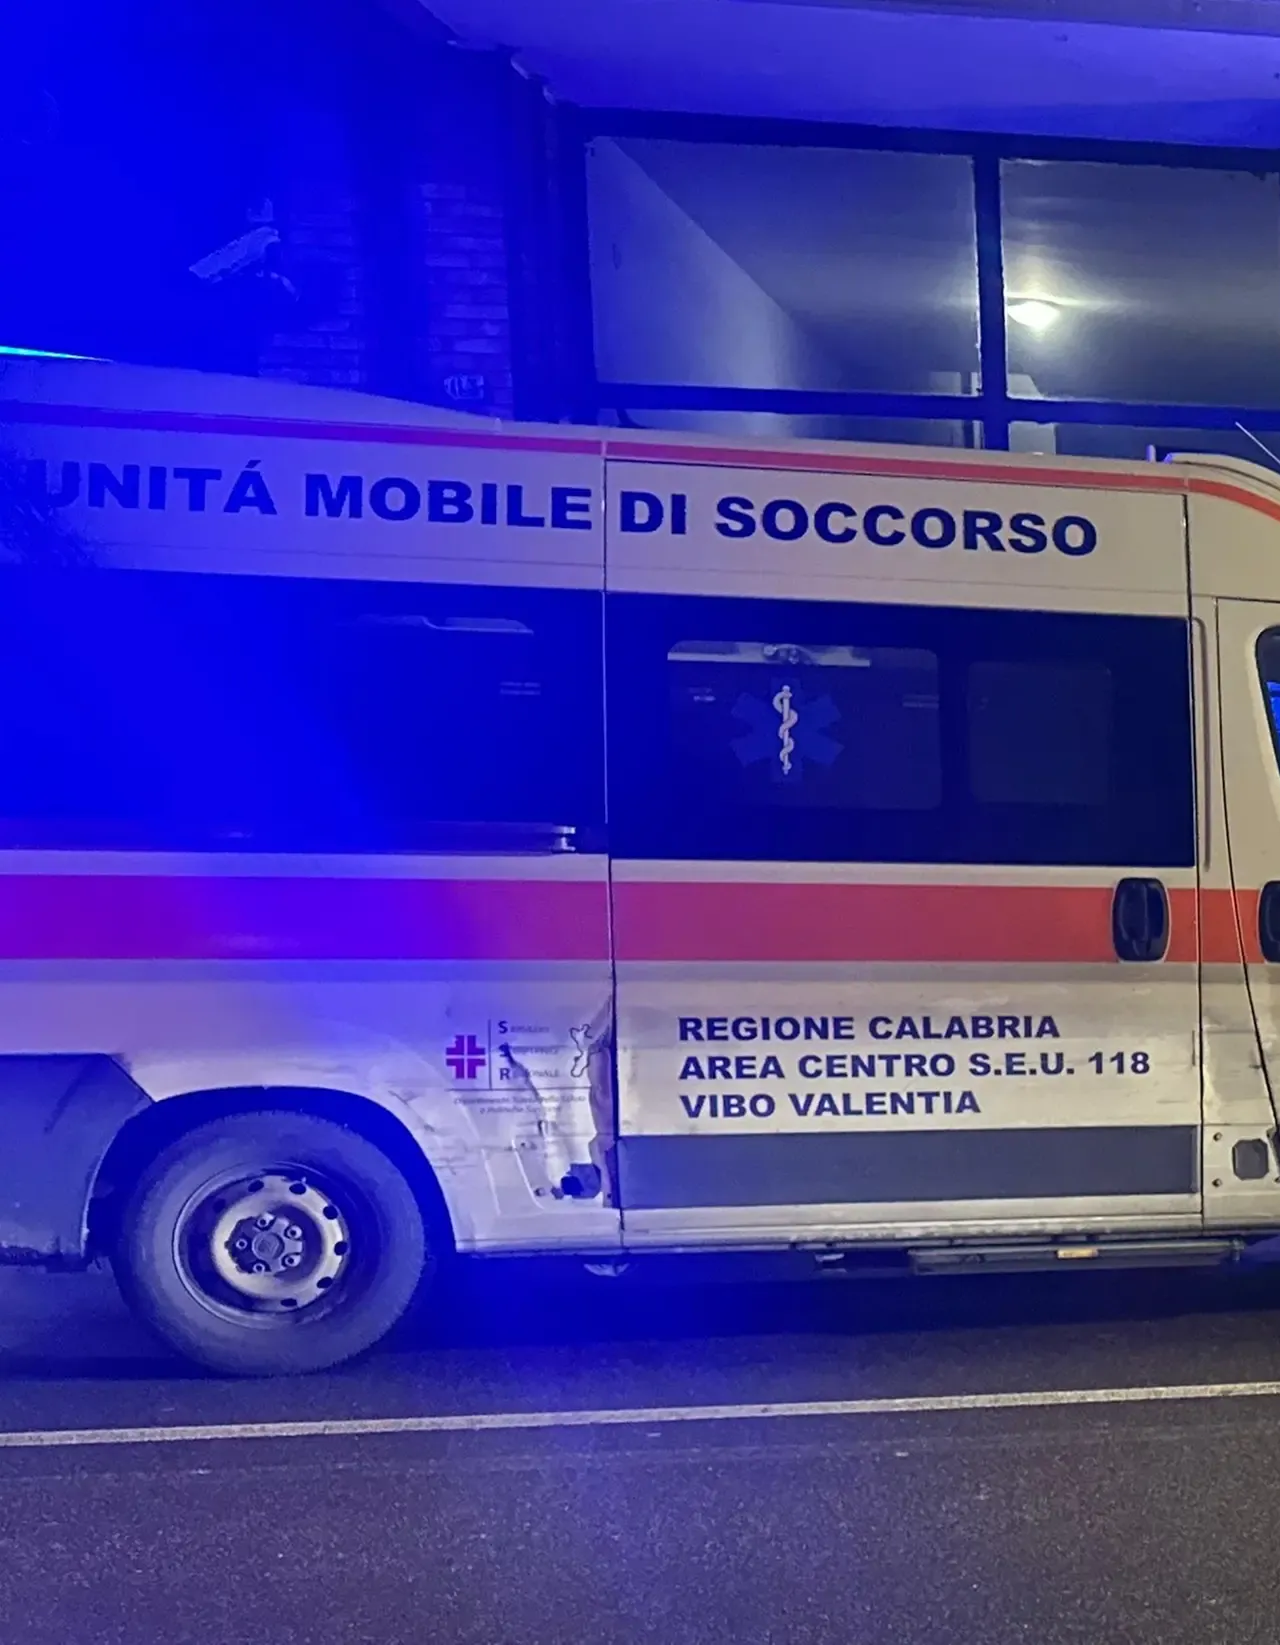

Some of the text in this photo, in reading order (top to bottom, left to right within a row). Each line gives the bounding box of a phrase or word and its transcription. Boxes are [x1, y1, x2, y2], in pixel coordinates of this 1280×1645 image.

[304, 472, 592, 530] MOBILE
[619, 490, 687, 535] DI
[714, 496, 1097, 556] SOCCORSO
[678, 1015, 1061, 1042] REGIONE CALABRIA
[678, 1051, 1150, 1080] AREA CENTRO S.E.U. 118
[681, 1090, 982, 1119] VIBO VALENTIA
